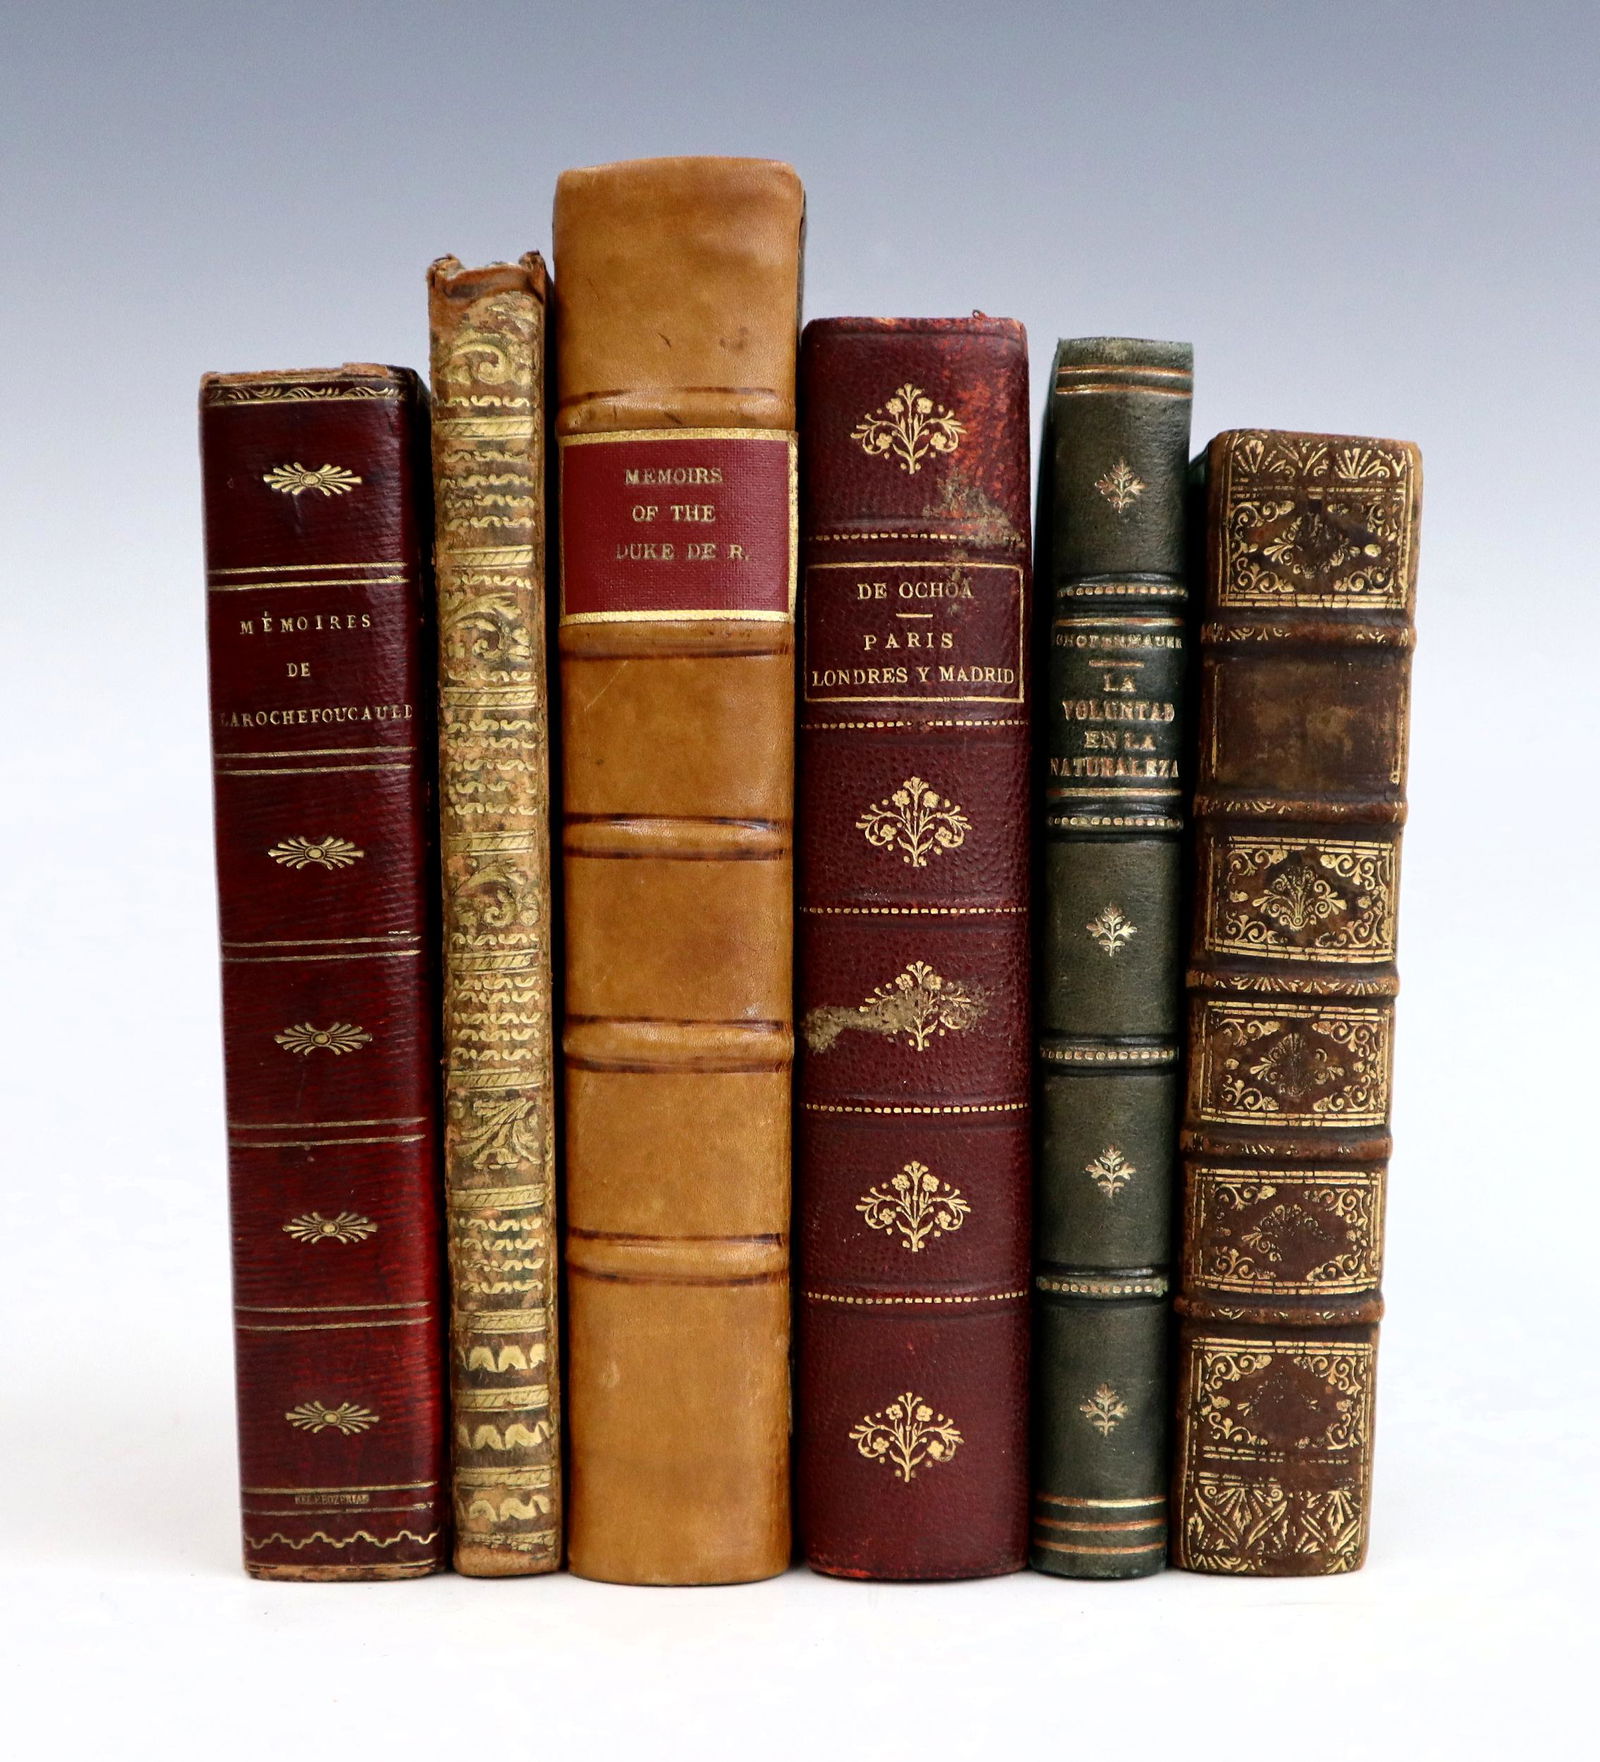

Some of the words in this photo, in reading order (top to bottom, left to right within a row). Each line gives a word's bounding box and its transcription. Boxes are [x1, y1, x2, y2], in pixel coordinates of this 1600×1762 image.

[625, 467, 723, 486] MEMOIRS
[632, 505, 659, 522] OF
[670, 504, 716, 522] THE
[616, 543, 675, 560] DUKE
[687, 543, 716, 560] DE
[857, 582, 887, 600] DE
[898, 578, 974, 599] OCHOA
[863, 632, 953, 650] PARIS
[286, 662, 311, 677] DE
[812, 666, 908, 687] LONDRES
[915, 666, 931, 682] Y
[938, 665, 1014, 684] MADRID
[1103, 673, 1137, 692] LA
[1062, 700, 1175, 722] VOLUNTAD
[1084, 730, 1117, 750] EN
[1124, 730, 1156, 751] LA
[1050, 756, 1179, 778] NATURALEZA
